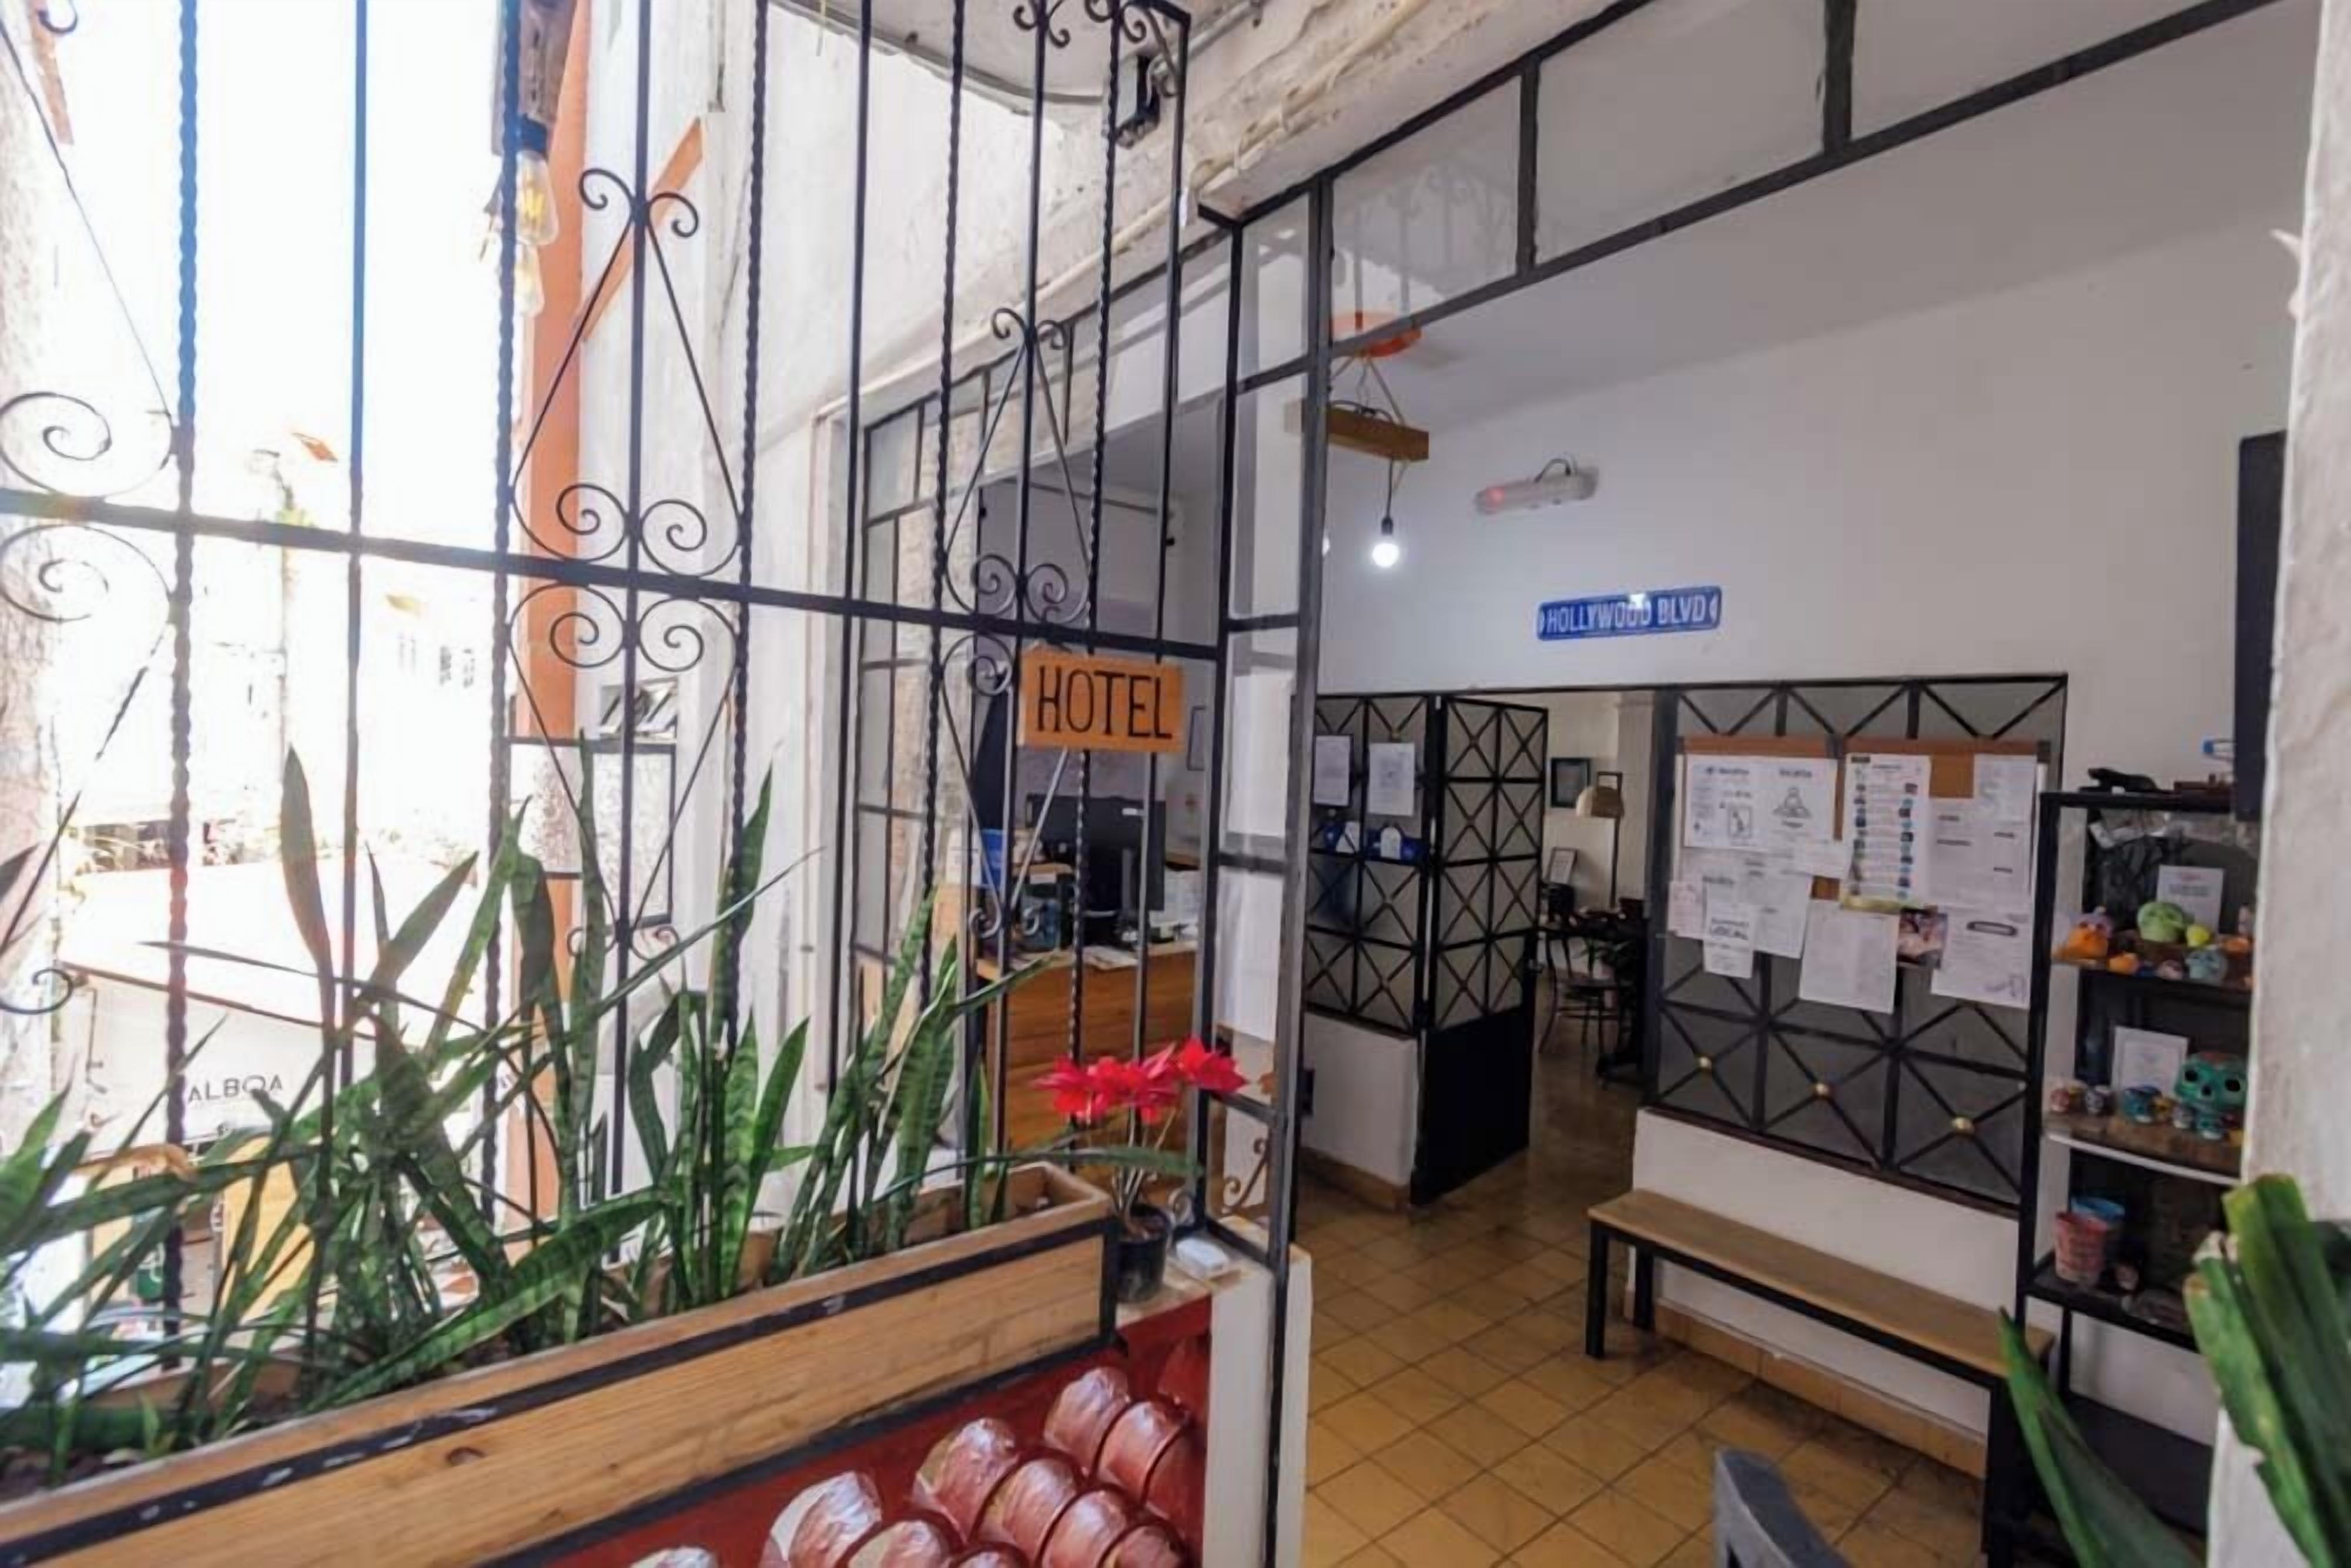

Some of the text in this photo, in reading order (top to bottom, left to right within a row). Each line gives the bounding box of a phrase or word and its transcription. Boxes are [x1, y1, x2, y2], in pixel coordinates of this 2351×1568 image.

[1546, 595, 1706, 633] HOLLYWOOD BLVD
[1037, 664, 1173, 739] HOTEL
